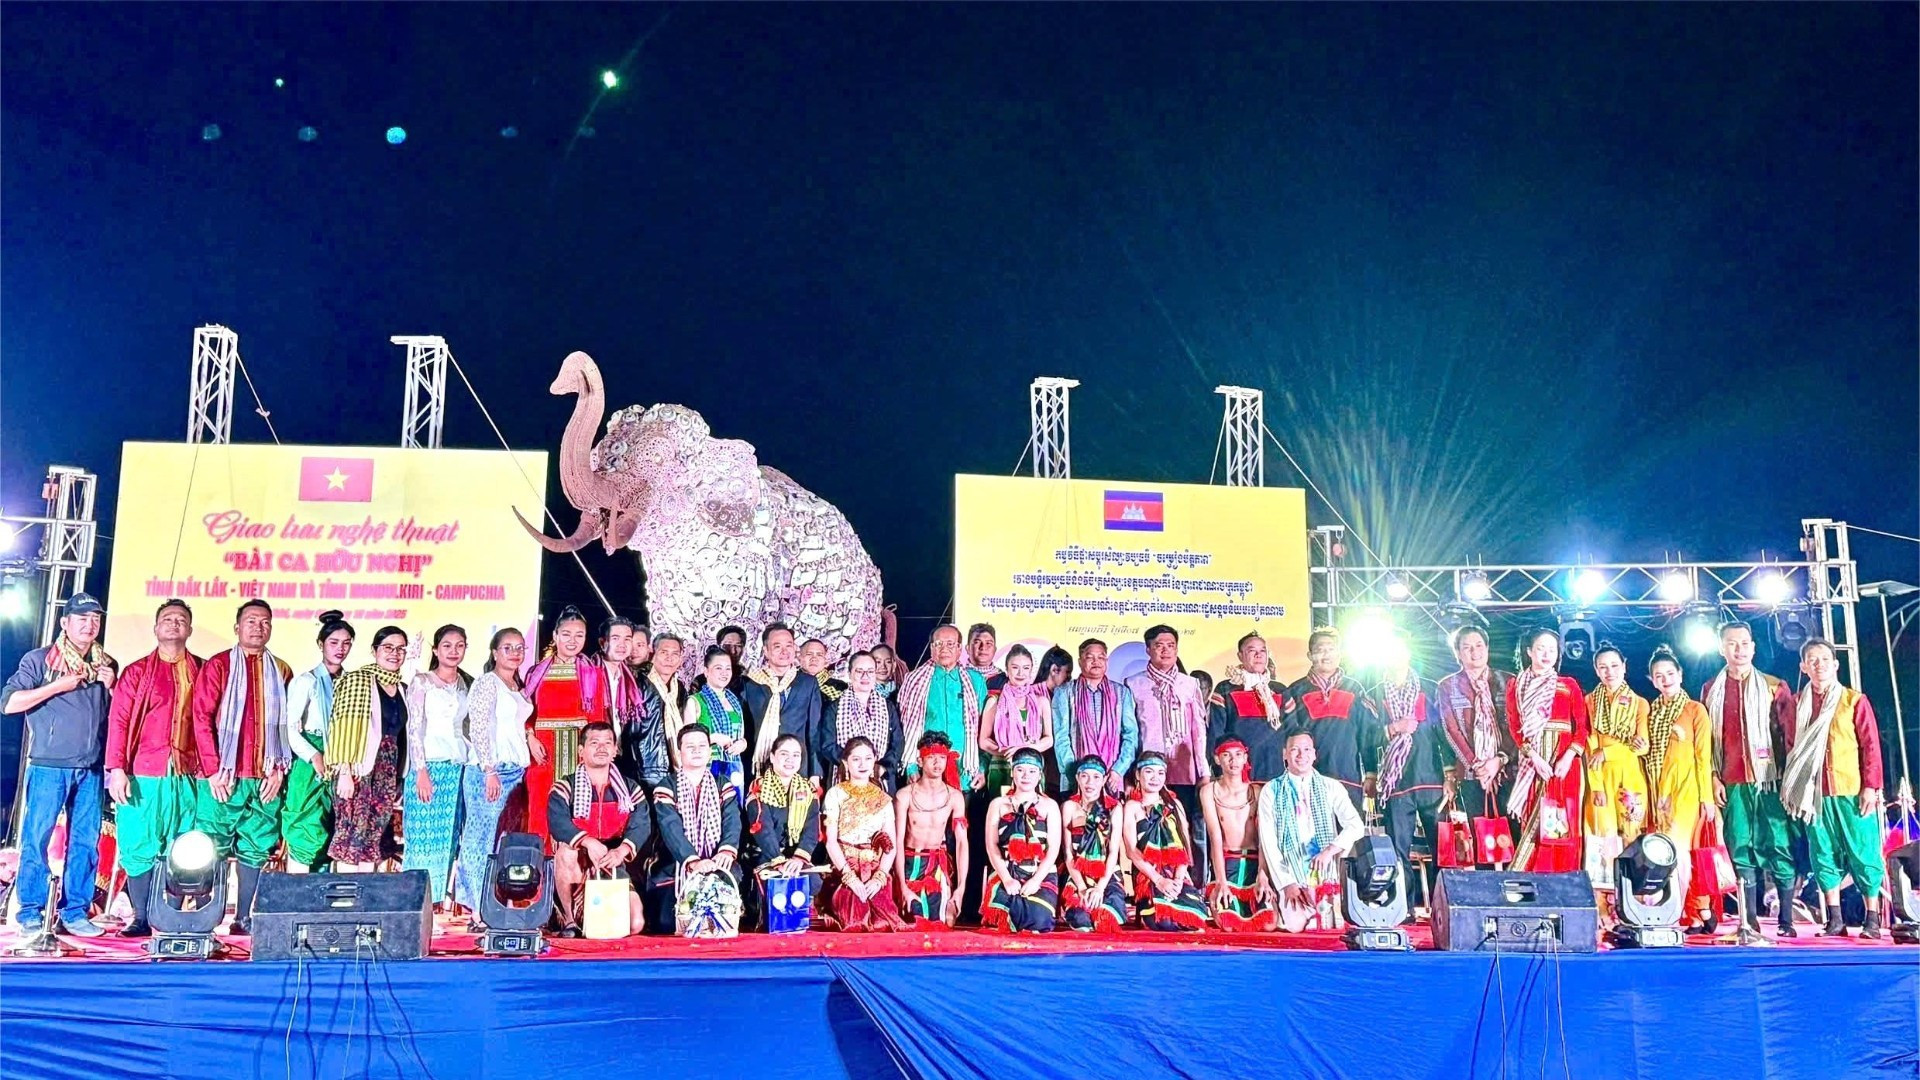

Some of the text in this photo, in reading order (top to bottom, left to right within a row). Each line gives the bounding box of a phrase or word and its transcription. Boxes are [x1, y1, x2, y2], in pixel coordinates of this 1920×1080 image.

[203, 510, 459, 546] Giao lưu nghệ thuật
[224, 548, 433, 578] “BÀI CA HỮU NGHỊ”
[145, 576, 174, 597] TỈNH
[176, 576, 202, 598] ĐẮK
[204, 576, 228, 598] LẮK
[239, 579, 265, 598] VIỆT
[267, 582, 298, 599] NAM
[300, 579, 316, 599] VÀ
[318, 578, 348, 599] TỈNH
[435, 584, 506, 601] CAMPUCHIA
